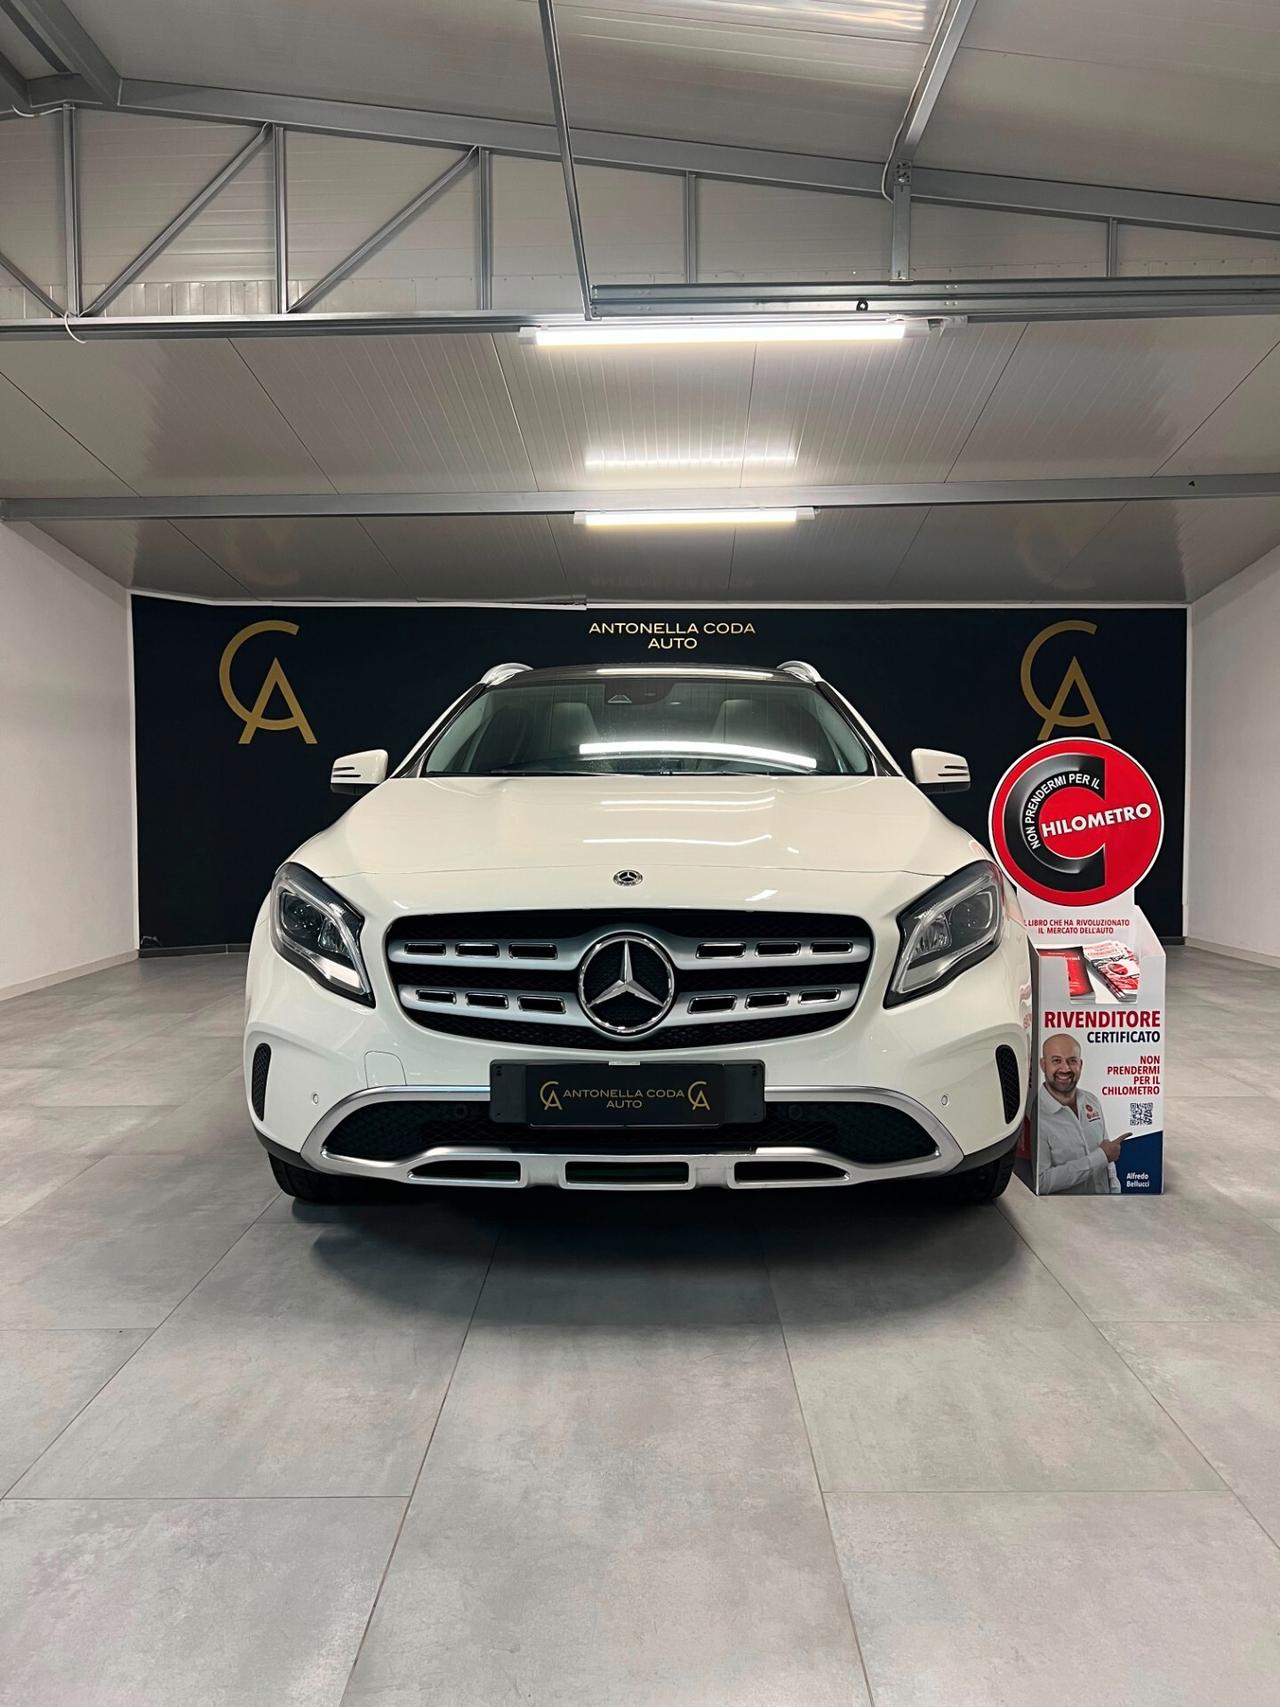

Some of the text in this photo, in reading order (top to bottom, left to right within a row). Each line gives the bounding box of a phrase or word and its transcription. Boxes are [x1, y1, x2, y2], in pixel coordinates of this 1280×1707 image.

[589, 623, 756, 634] ANTONELLA CODA
[648, 637, 698, 649] AUTO
[1025, 773, 1101, 850] NON PRENDERMI PER IL
[1044, 1011, 1161, 1029] RIVENDITORE
[1087, 1031, 1161, 1043] CERTIFICATO
[1140, 1055, 1160, 1065] NON
[1107, 1066, 1160, 1075] PRENDERMI
[1134, 1076, 1161, 1085] PER IL
[562, 1089, 686, 1098] ANTONELLA CODA
[1102, 1086, 1160, 1095] CHILOMETRO
[606, 1099, 643, 1109] AUTO
[1126, 1172, 1149, 1180] Alfredo
[1126, 1180, 1150, 1188] Bellucci
